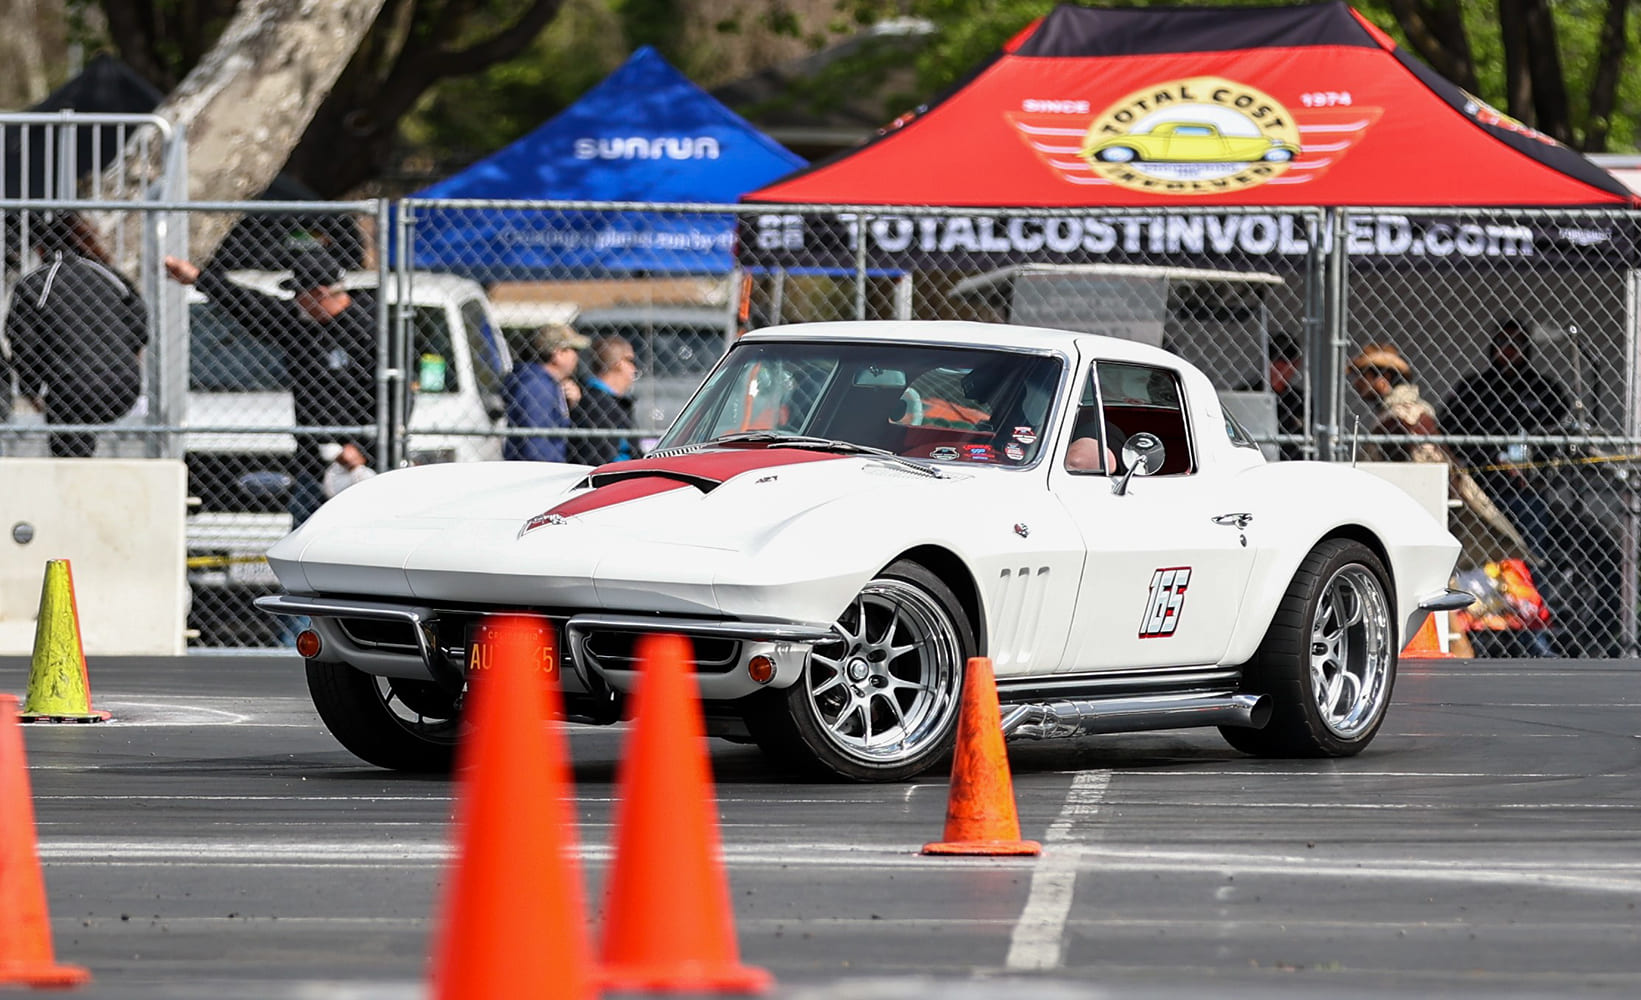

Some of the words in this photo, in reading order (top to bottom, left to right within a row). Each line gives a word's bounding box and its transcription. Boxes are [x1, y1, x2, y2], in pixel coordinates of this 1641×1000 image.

[1022, 98, 1090, 114] SINCE
[1102, 85, 1199, 135] TOTAL
[1211, 88, 1287, 131] COST
[1300, 91, 1353, 108] 1974
[1138, 566, 1192, 639] 165
